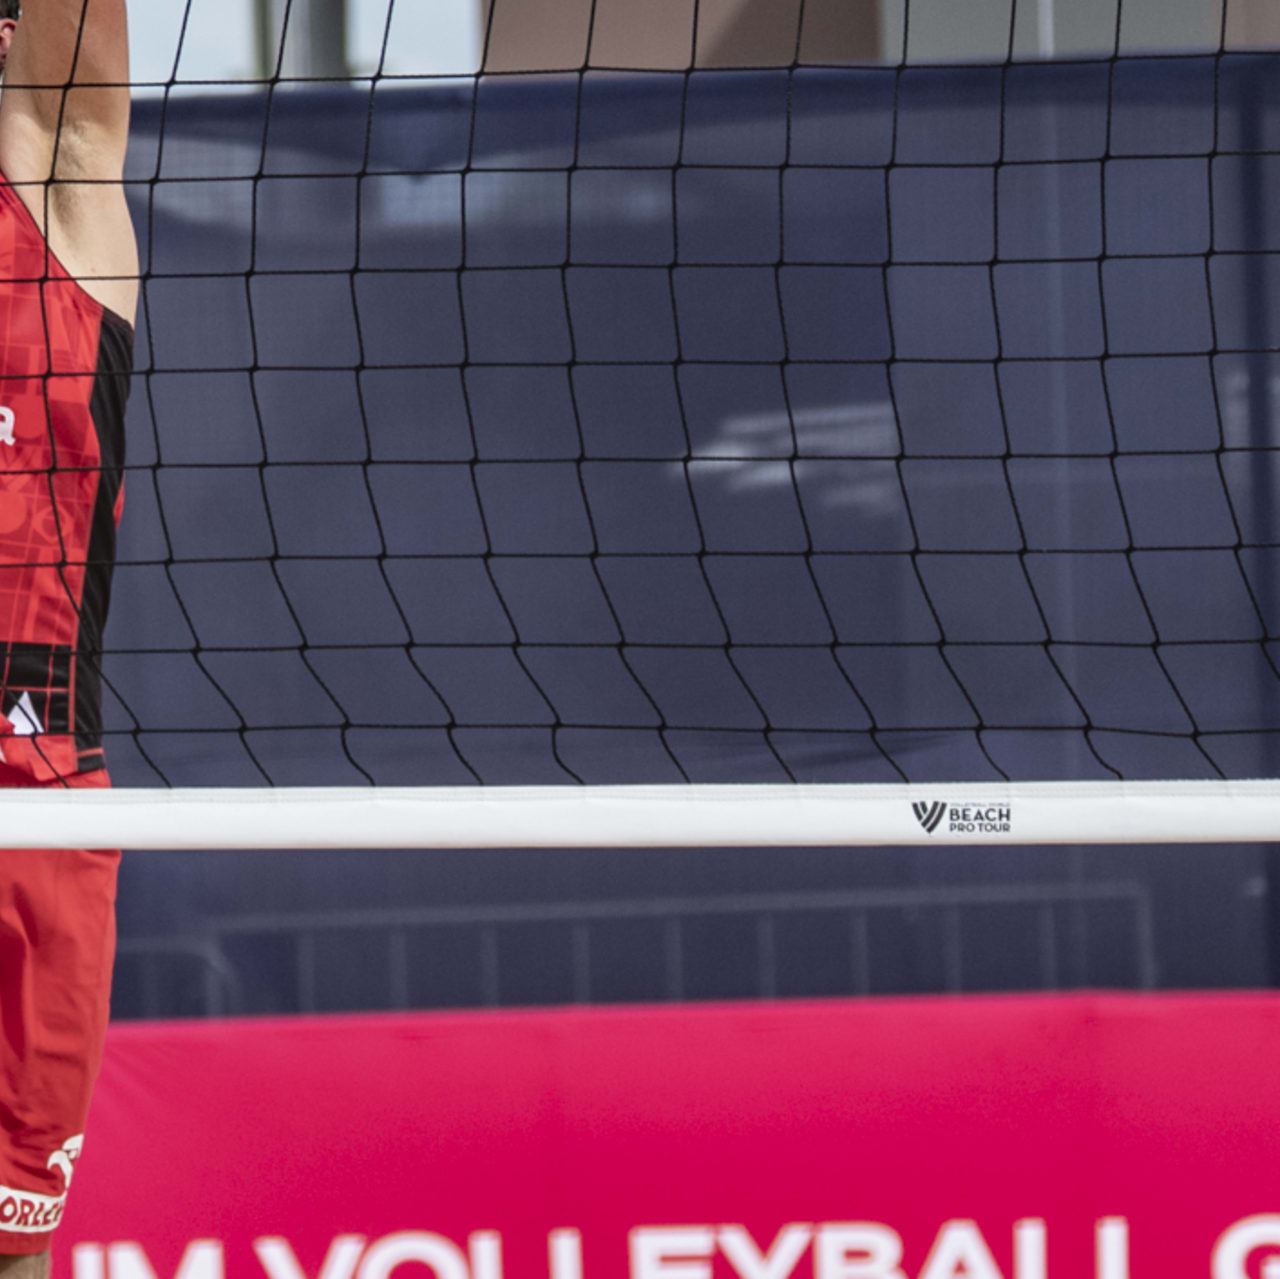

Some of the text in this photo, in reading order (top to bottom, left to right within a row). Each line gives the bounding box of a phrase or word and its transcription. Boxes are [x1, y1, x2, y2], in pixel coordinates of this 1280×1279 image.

[949, 808, 1011, 821] BEACH
[949, 822, 1011, 832] PRO TOUR
